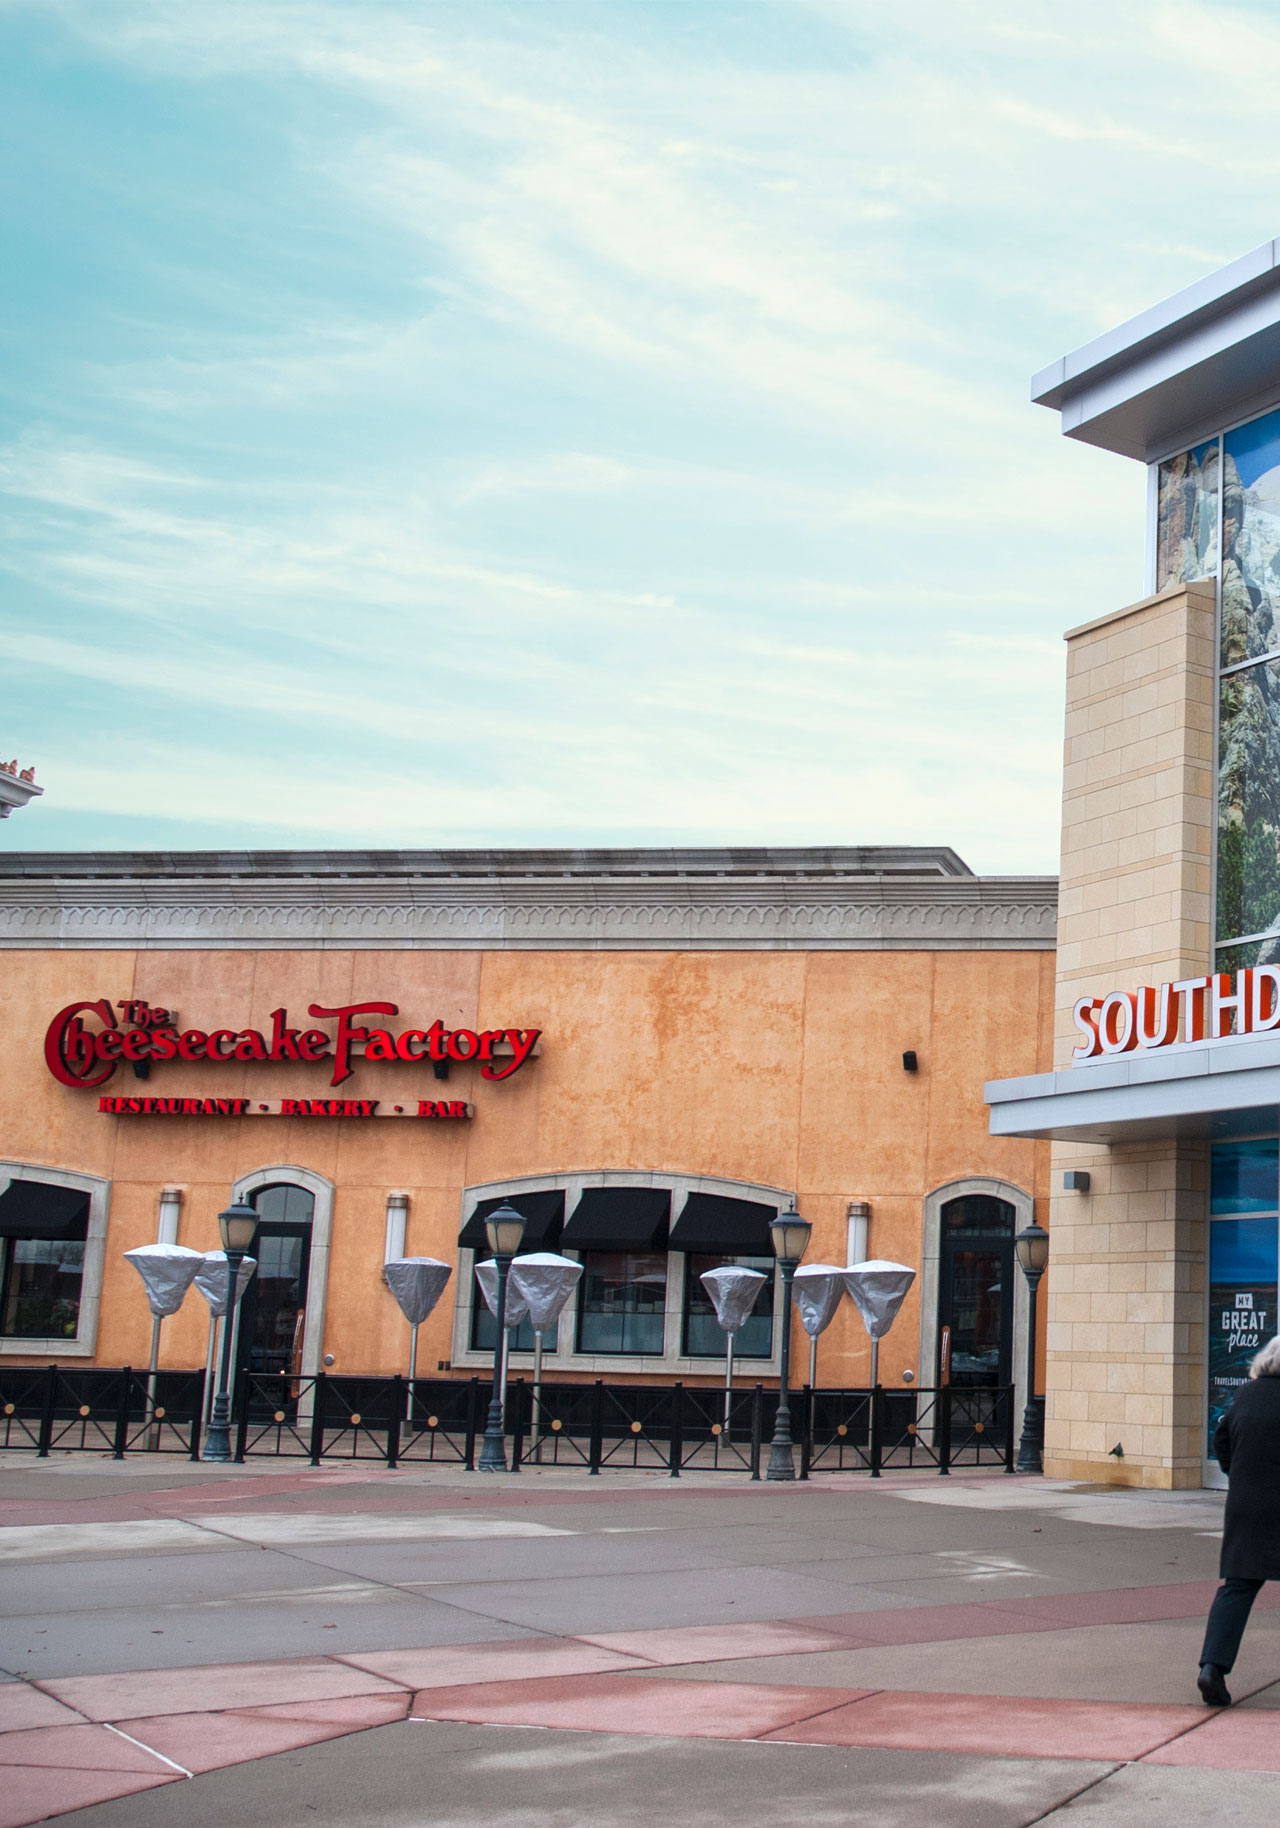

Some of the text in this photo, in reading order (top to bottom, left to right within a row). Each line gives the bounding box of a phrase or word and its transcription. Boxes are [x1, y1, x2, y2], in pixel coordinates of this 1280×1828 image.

[117, 1000, 169, 1028] The
[44, 998, 542, 1088] Cheesecake Factory
[98, 1096, 469, 1119] RESTAURANT BAKERY BAR
[1238, 1295, 1250, 1306] MY
[1222, 1311, 1266, 1330] GREAT
[1227, 1328, 1259, 1353] place
